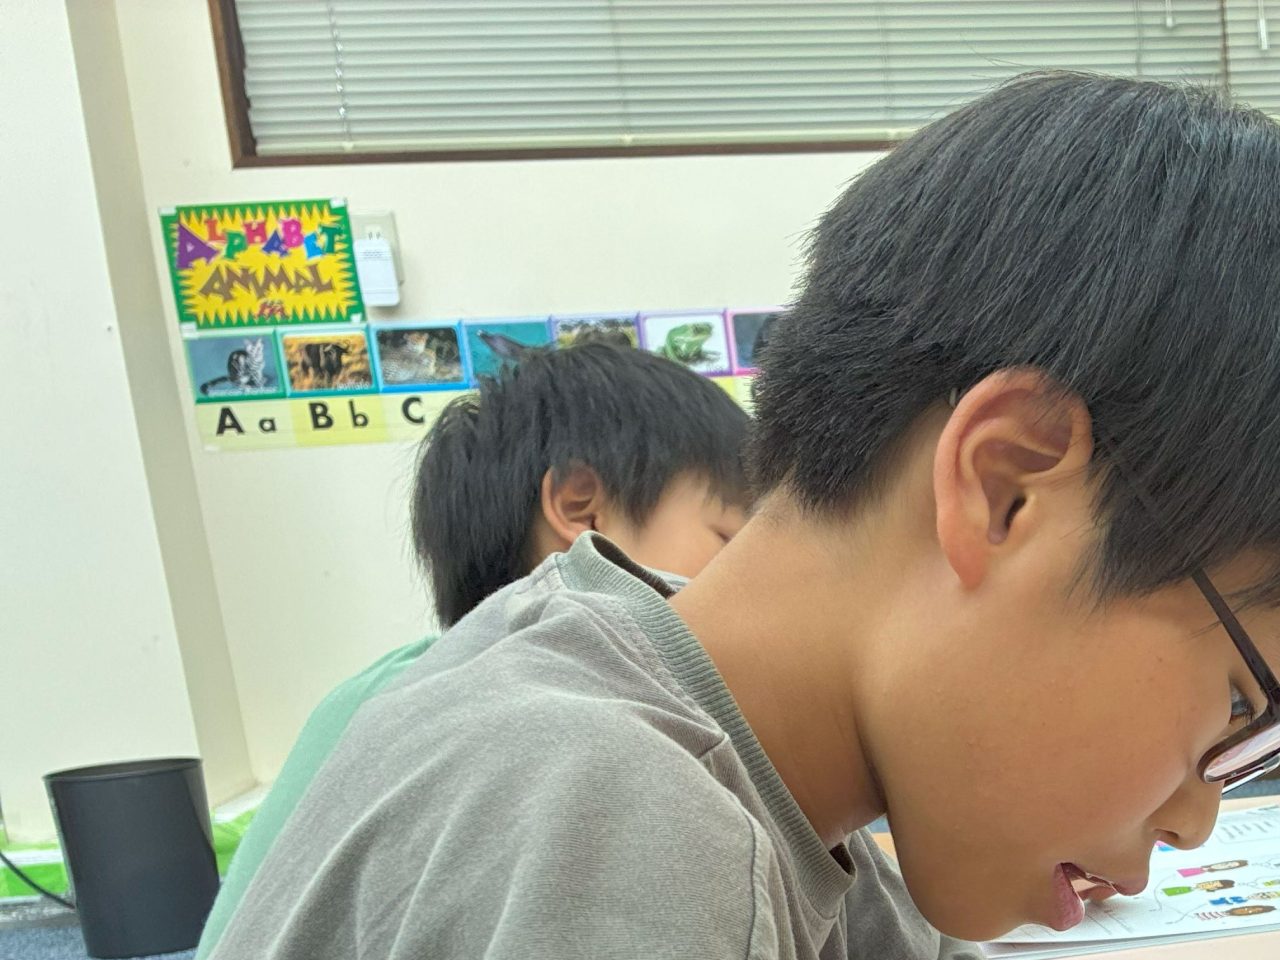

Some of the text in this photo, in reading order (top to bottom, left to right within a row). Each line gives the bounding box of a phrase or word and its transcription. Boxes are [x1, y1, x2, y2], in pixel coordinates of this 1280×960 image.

[176, 218, 345, 269] ALPHABET
[200, 264, 333, 302] ANIMAL
[216, 397, 424, 436] A a B b C
